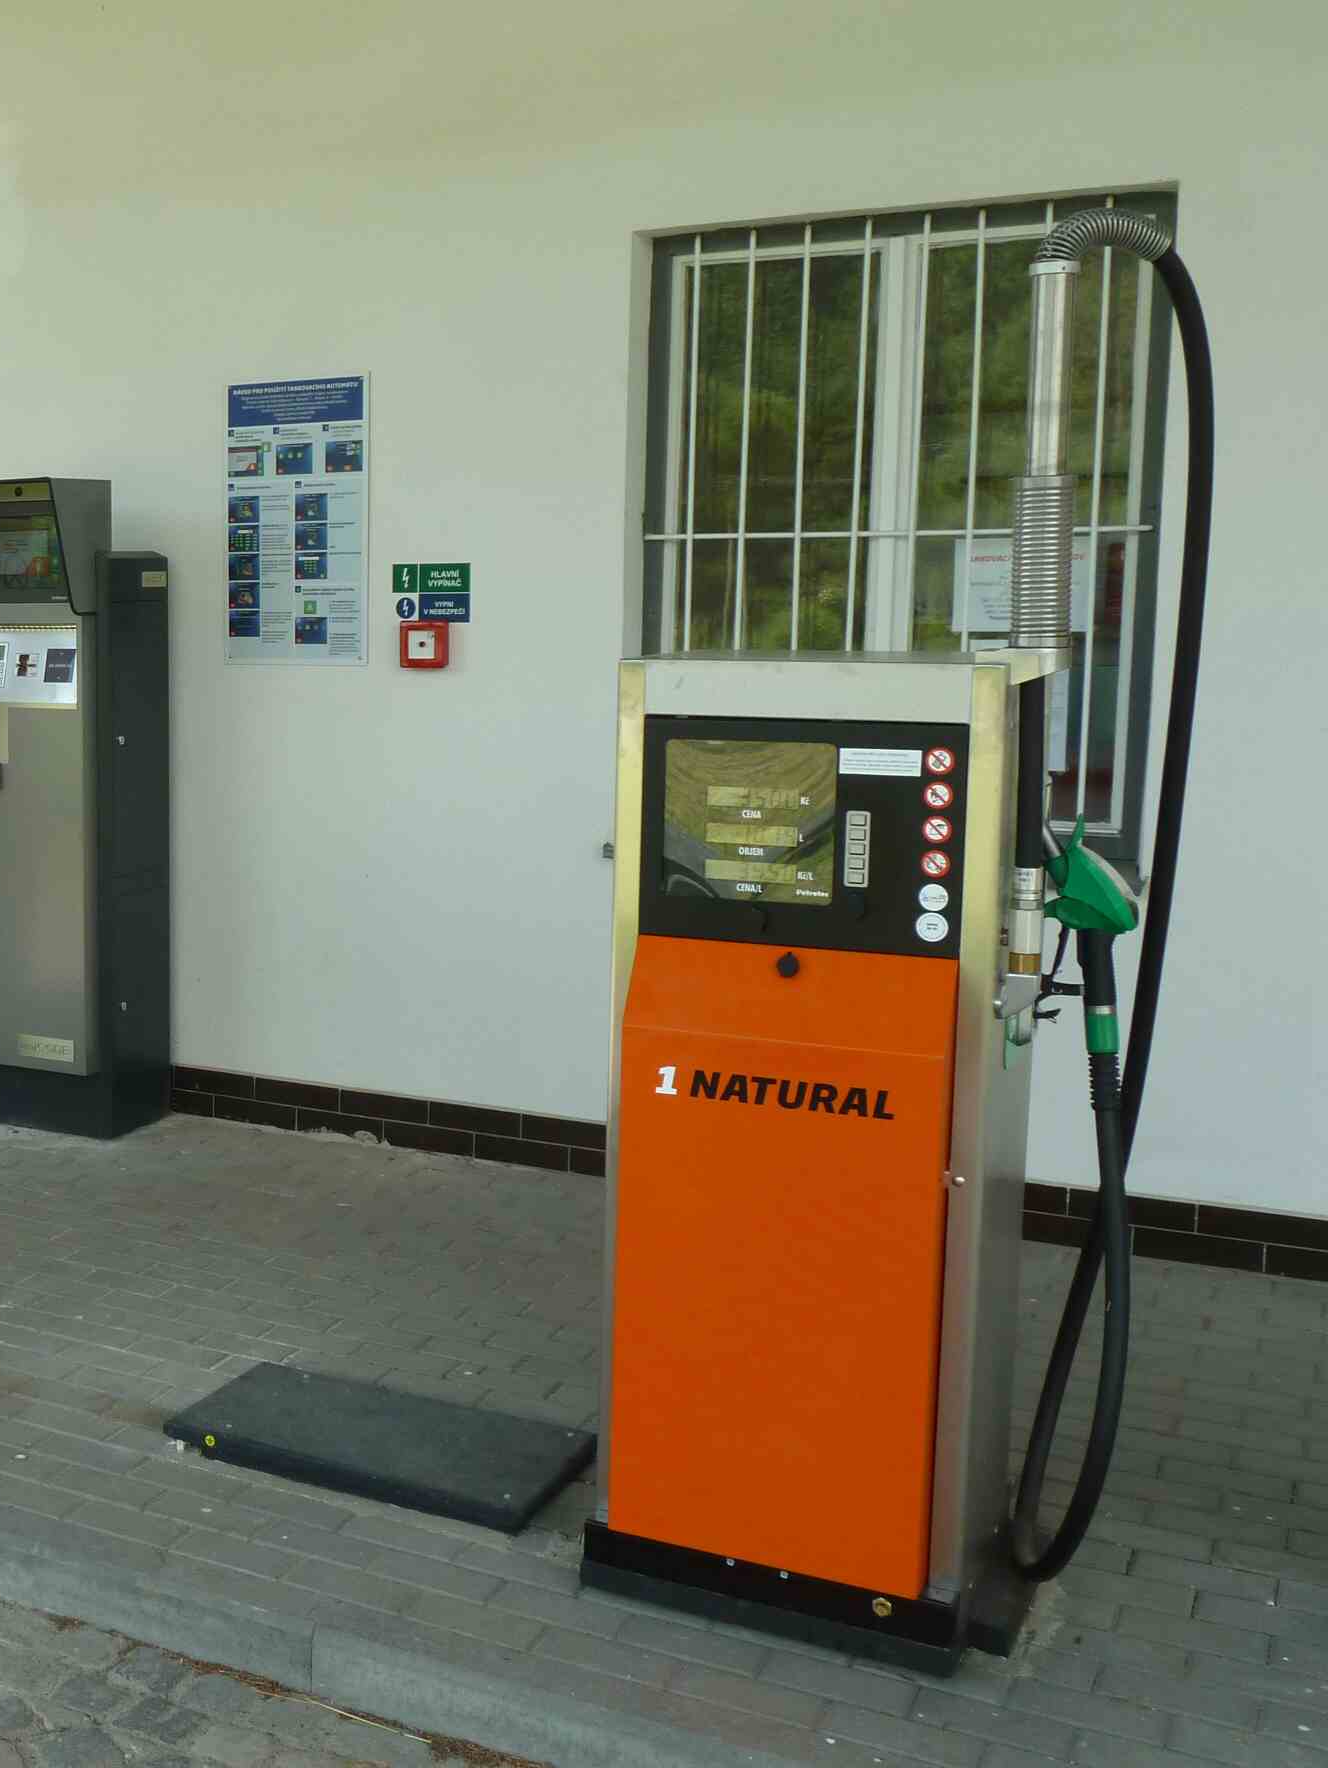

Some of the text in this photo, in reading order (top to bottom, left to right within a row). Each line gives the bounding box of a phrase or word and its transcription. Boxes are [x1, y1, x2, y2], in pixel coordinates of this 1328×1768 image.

[741, 810, 762, 819] CENA
[655, 1065, 895, 1121] 1 NATURAL
